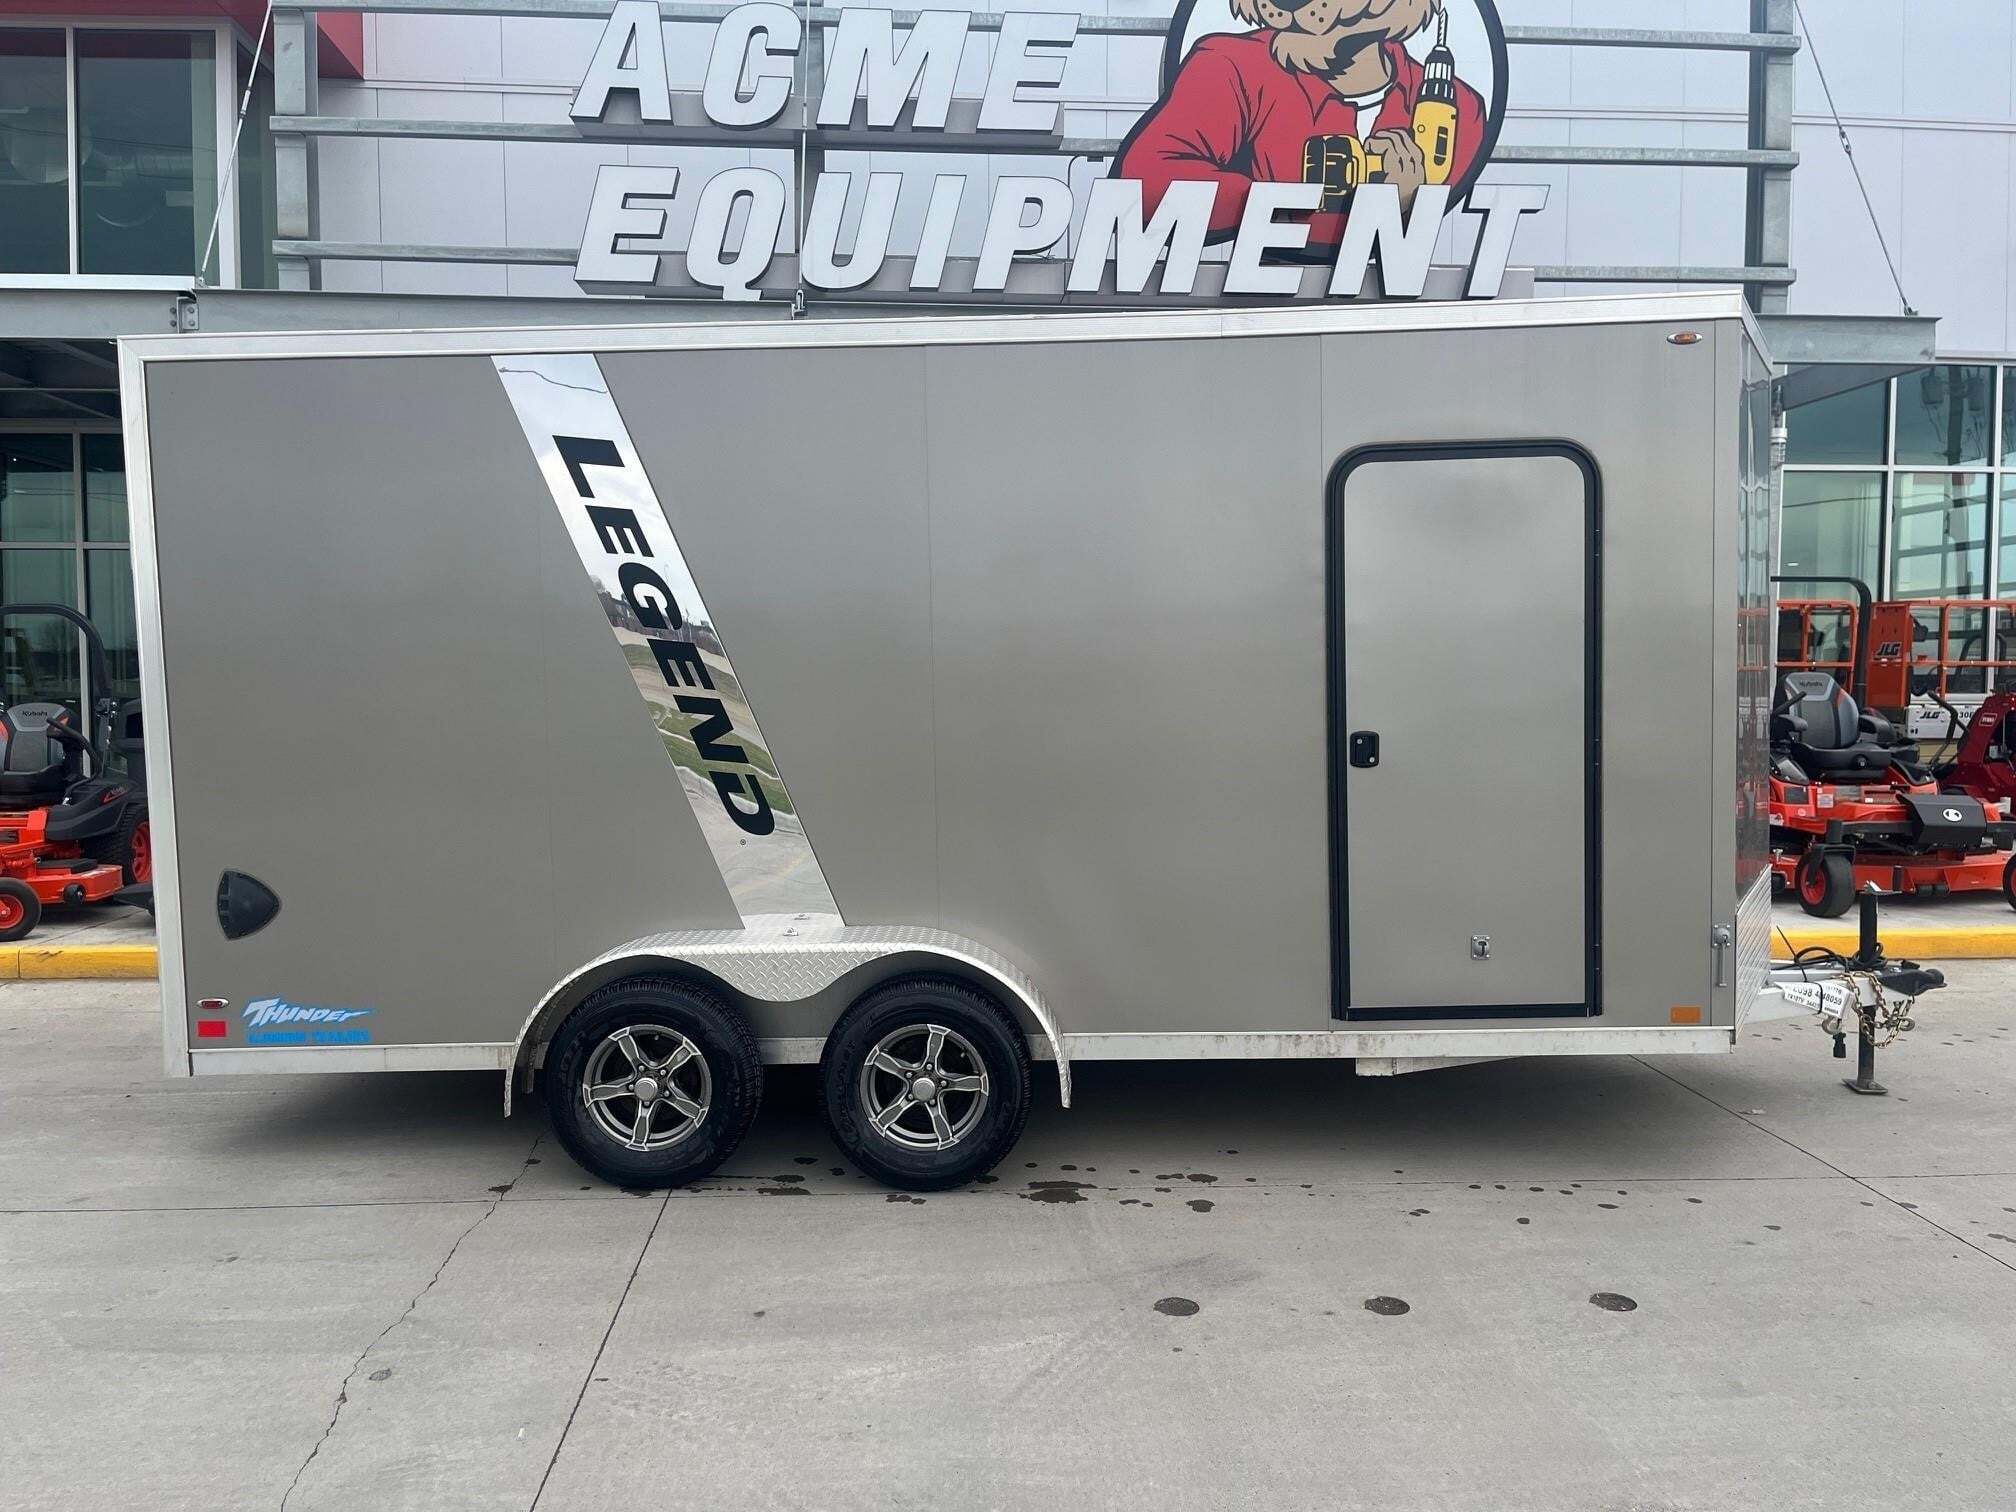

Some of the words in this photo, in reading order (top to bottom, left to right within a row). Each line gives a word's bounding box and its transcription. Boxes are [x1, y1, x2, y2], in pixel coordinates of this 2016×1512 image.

[569, 0, 1081, 131] ACME
[574, 165, 1551, 300] EQUIPMENT
[553, 435, 774, 836] LEGEND
[1876, 642, 1902, 656] JLG
[1920, 711, 1941, 719] JLG
